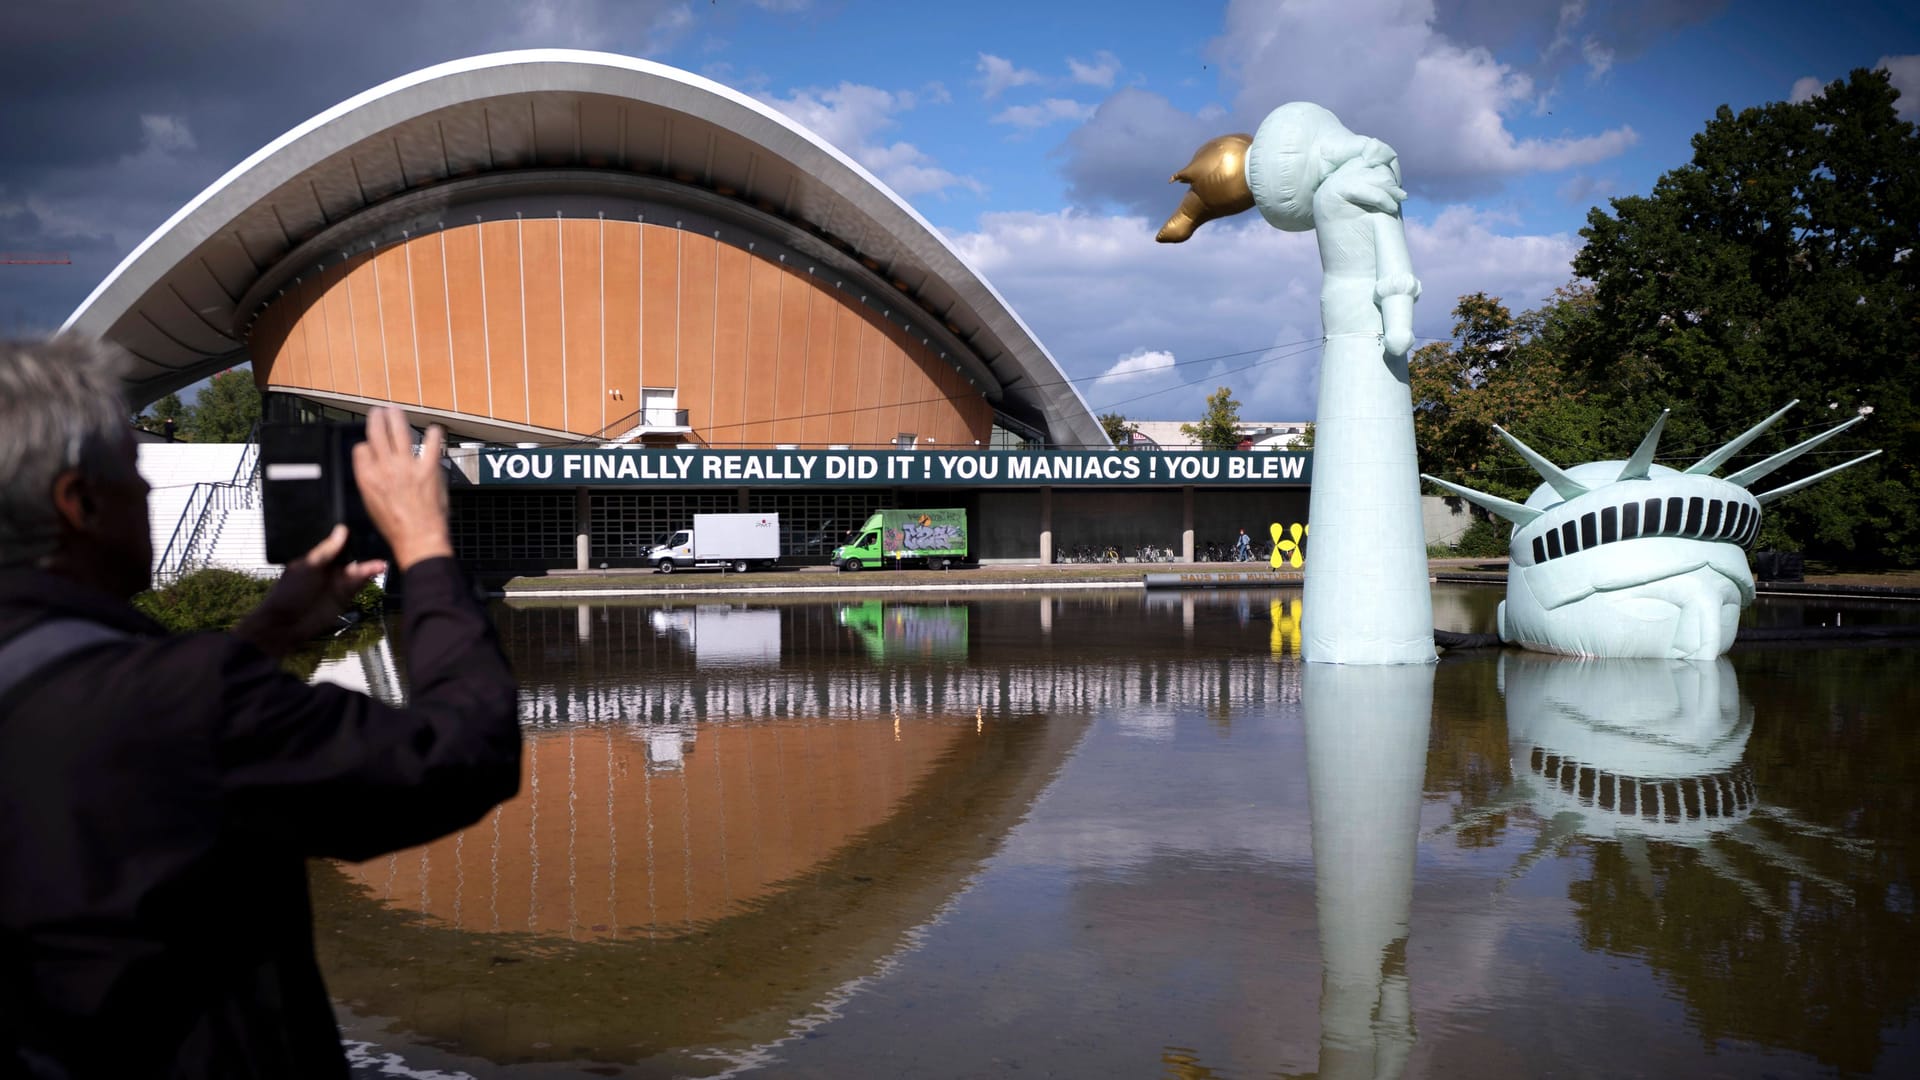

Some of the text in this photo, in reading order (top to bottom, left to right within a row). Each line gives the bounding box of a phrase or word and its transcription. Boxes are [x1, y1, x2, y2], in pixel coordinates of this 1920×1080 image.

[485, 454, 1306, 480] YOU FINALLY REALLY DID IT ! YOU MANIACS ! YOU BLEW
[1180, 573, 1212, 583] HAUS
[1218, 573, 1240, 583] DER
